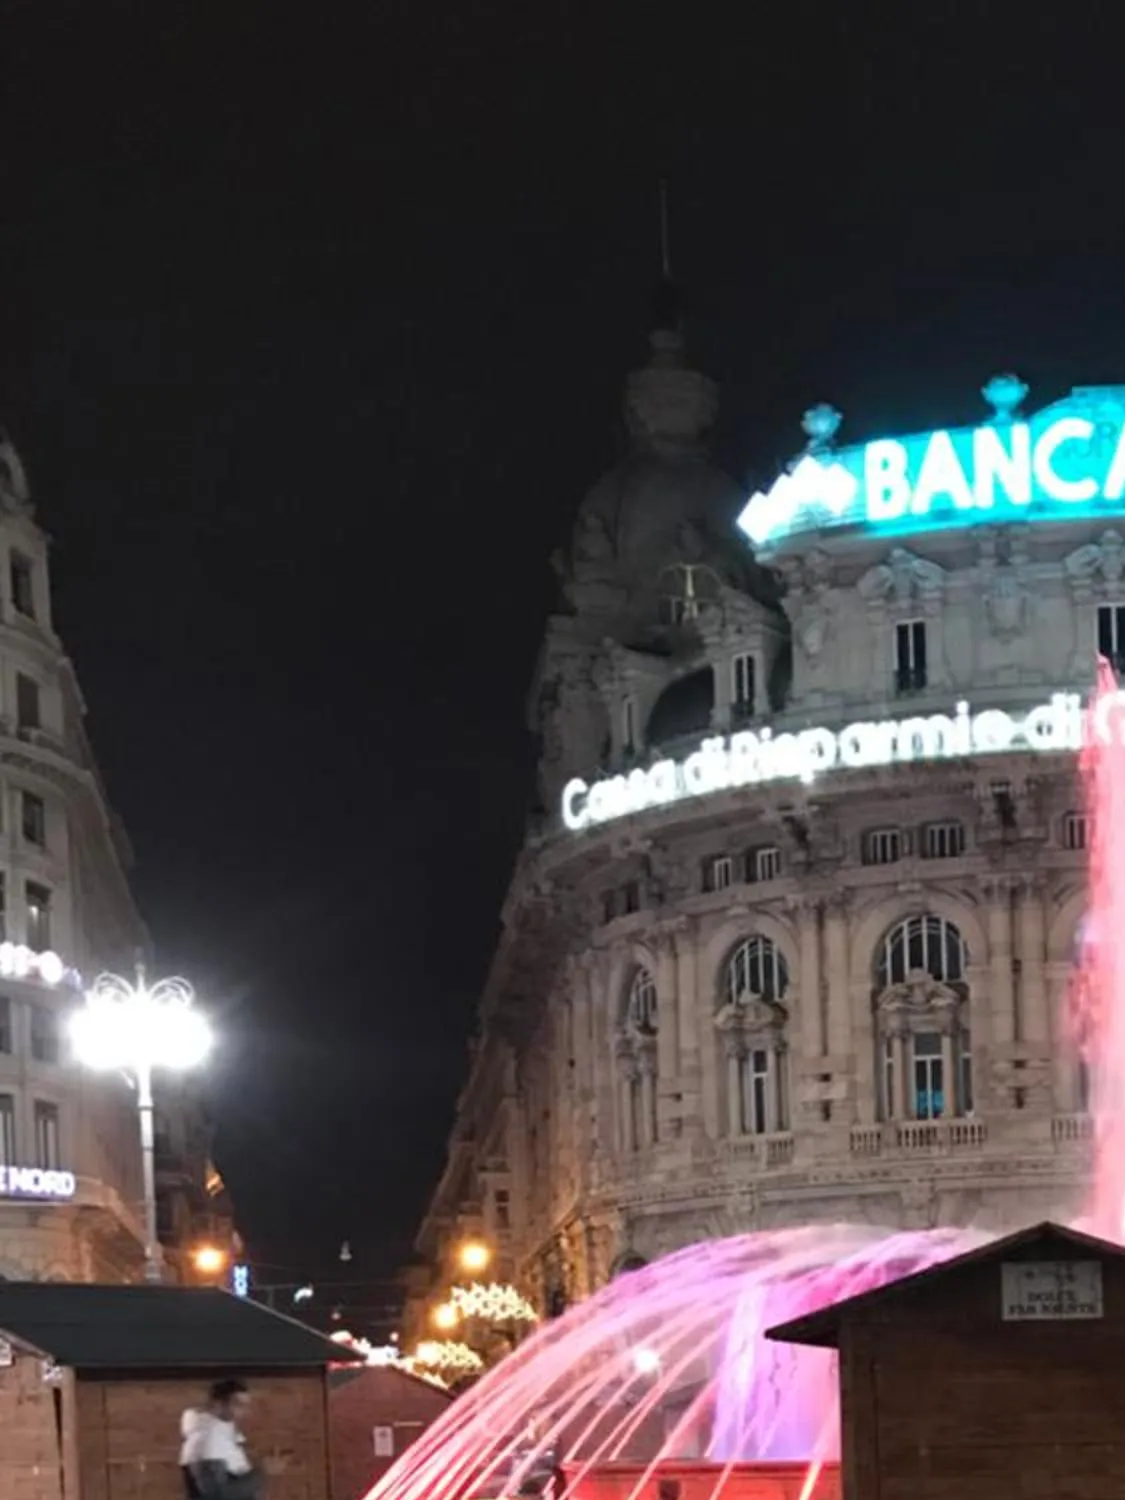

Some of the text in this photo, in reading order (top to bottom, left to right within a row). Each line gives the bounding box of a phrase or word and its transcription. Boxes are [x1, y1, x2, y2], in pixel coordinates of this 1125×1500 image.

[562, 758, 678, 831] Cassa
[682, 735, 726, 796] di
[730, 699, 1015, 786] Risparmio
[1022, 691, 1083, 750] di
[8, 1165, 76, 1197] NORD
